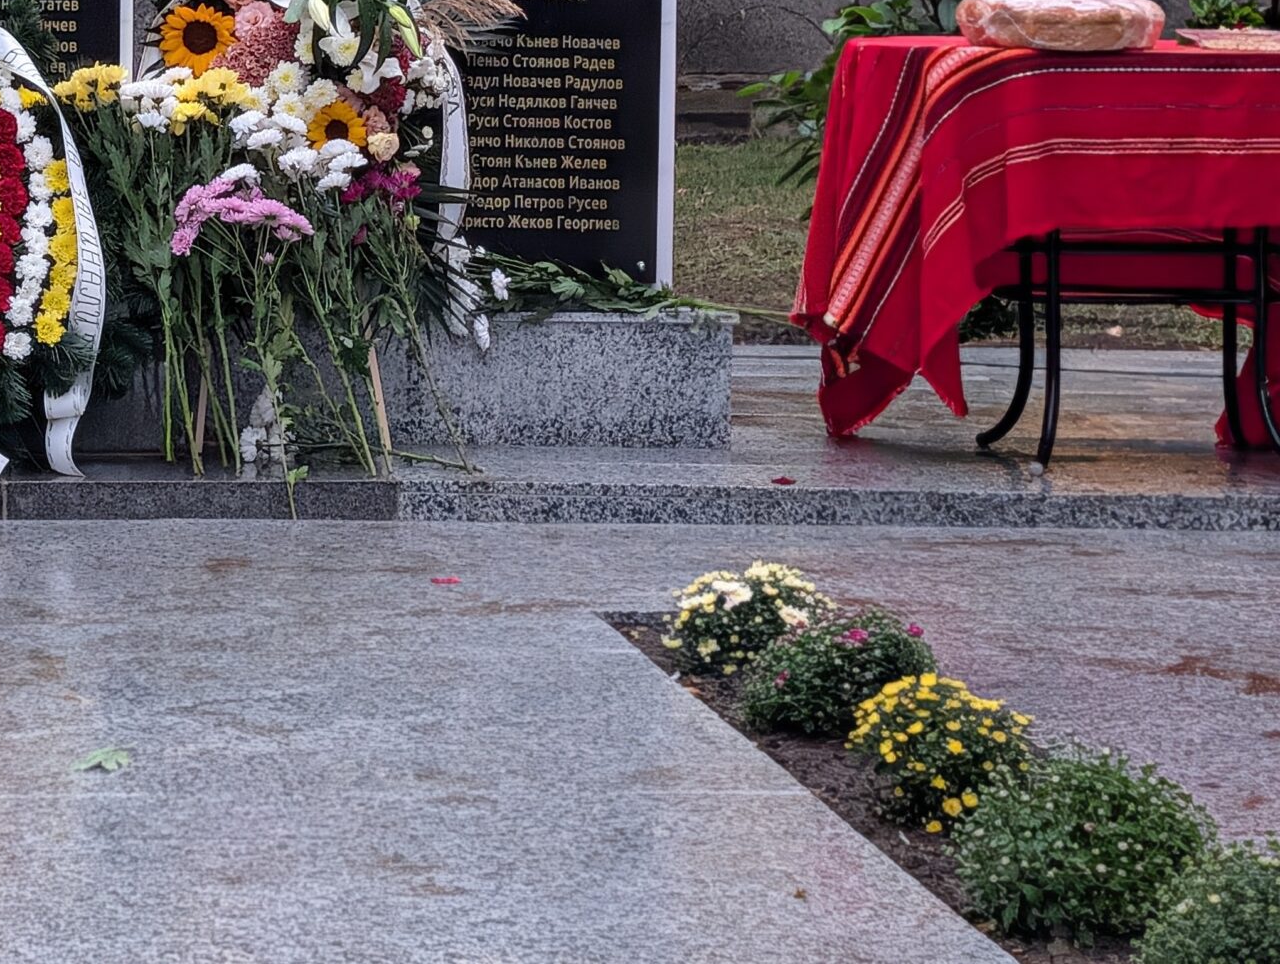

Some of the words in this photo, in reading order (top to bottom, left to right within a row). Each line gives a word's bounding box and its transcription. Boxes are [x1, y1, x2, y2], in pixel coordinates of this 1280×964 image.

[517, 34, 558, 48] Кънев
[562, 36, 620, 50] Новачев
[467, 53, 509, 67] Пеньо
[513, 54, 569, 68] Стоянов
[573, 55, 615, 71] Радев
[468, 75, 499, 90] адул
[503, 74, 561, 88] Новачев
[565, 75, 623, 91] Радулов
[468, 94, 494, 110] уси
[498, 94, 566, 109] Недялков
[570, 95, 617, 109] Ганчев
[469, 114, 499, 130] Руси
[503, 114, 560, 128] Стоянов
[564, 115, 612, 129] Костов
[470, 136, 501, 147] анчо
[505, 134, 564, 148] Николов
[568, 135, 626, 149] Стоянов
[471, 153, 511, 168] Стоян
[515, 154, 557, 168] Кънев
[560, 155, 607, 169] Желев
[502, 174, 565, 188] Атанасов
[569, 176, 620, 189] Иванов
[514, 194, 564, 211] Петров
[568, 196, 608, 212] Русев
[465, 216, 504, 230] ристо
[508, 214, 553, 228] Жеков
[557, 216, 620, 232] Георгиев
[71, 181, 102, 350] ЗАГИНАЛИ
